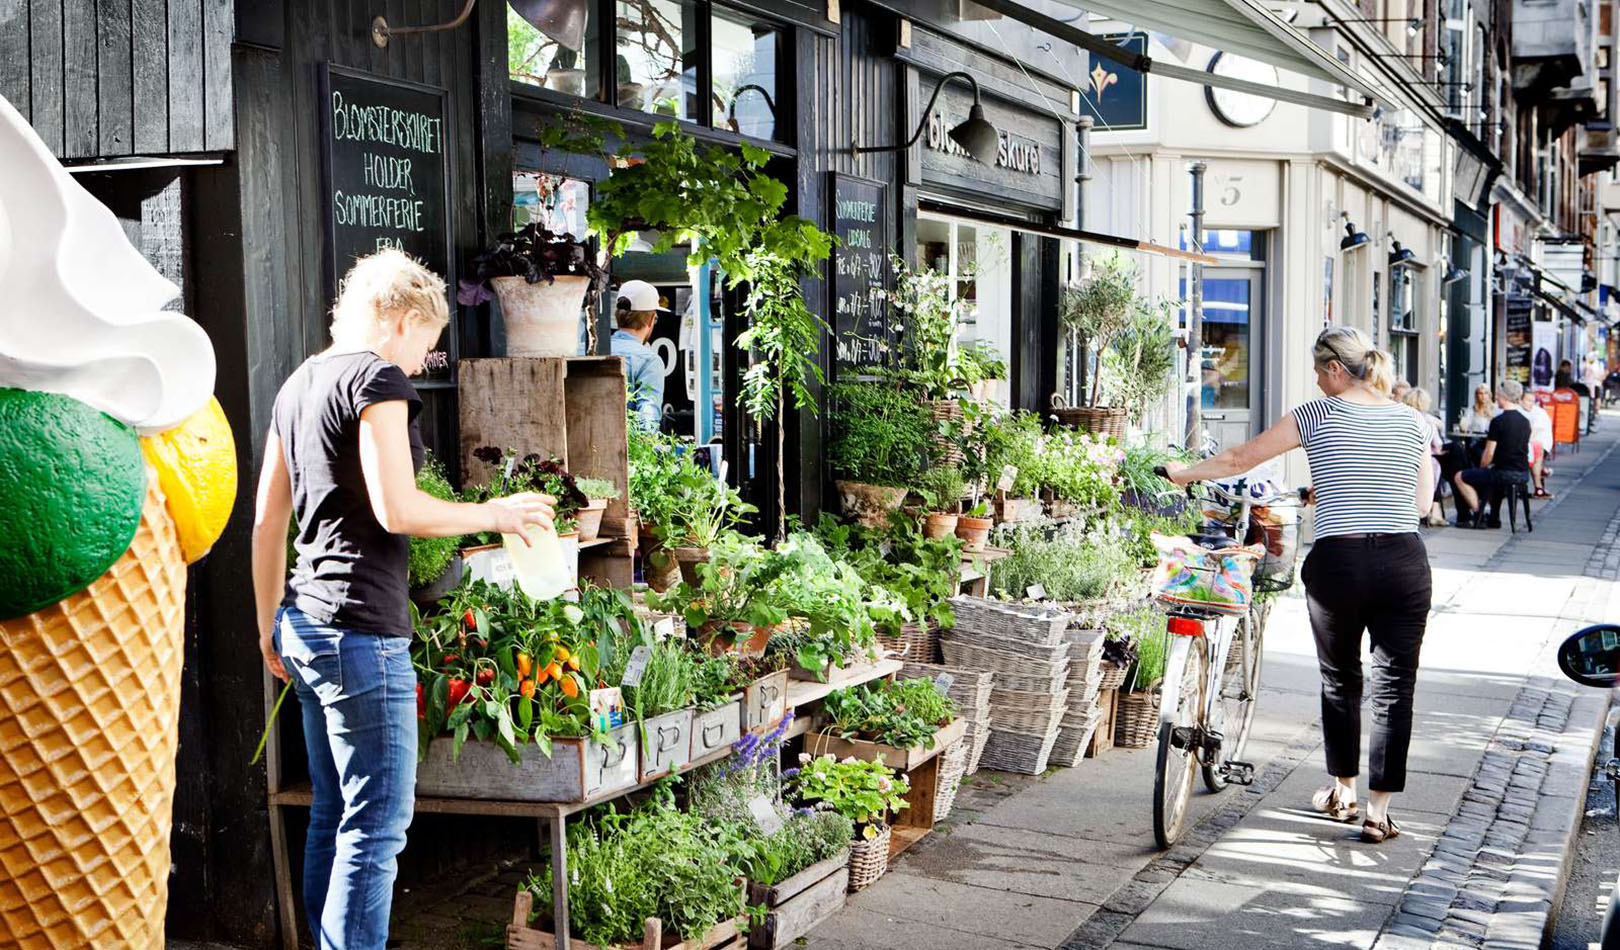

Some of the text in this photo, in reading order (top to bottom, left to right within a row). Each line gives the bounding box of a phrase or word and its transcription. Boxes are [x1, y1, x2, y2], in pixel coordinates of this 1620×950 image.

[332, 90, 441, 153] BLOMSTERSKURET
[927, 112, 1042, 175] bloskuret
[363, 153, 416, 195] HOLDER
[1220, 176, 1244, 206] 5
[334, 189, 424, 231] SOMMERFERIE
[847, 228, 872, 249] UDSALG
